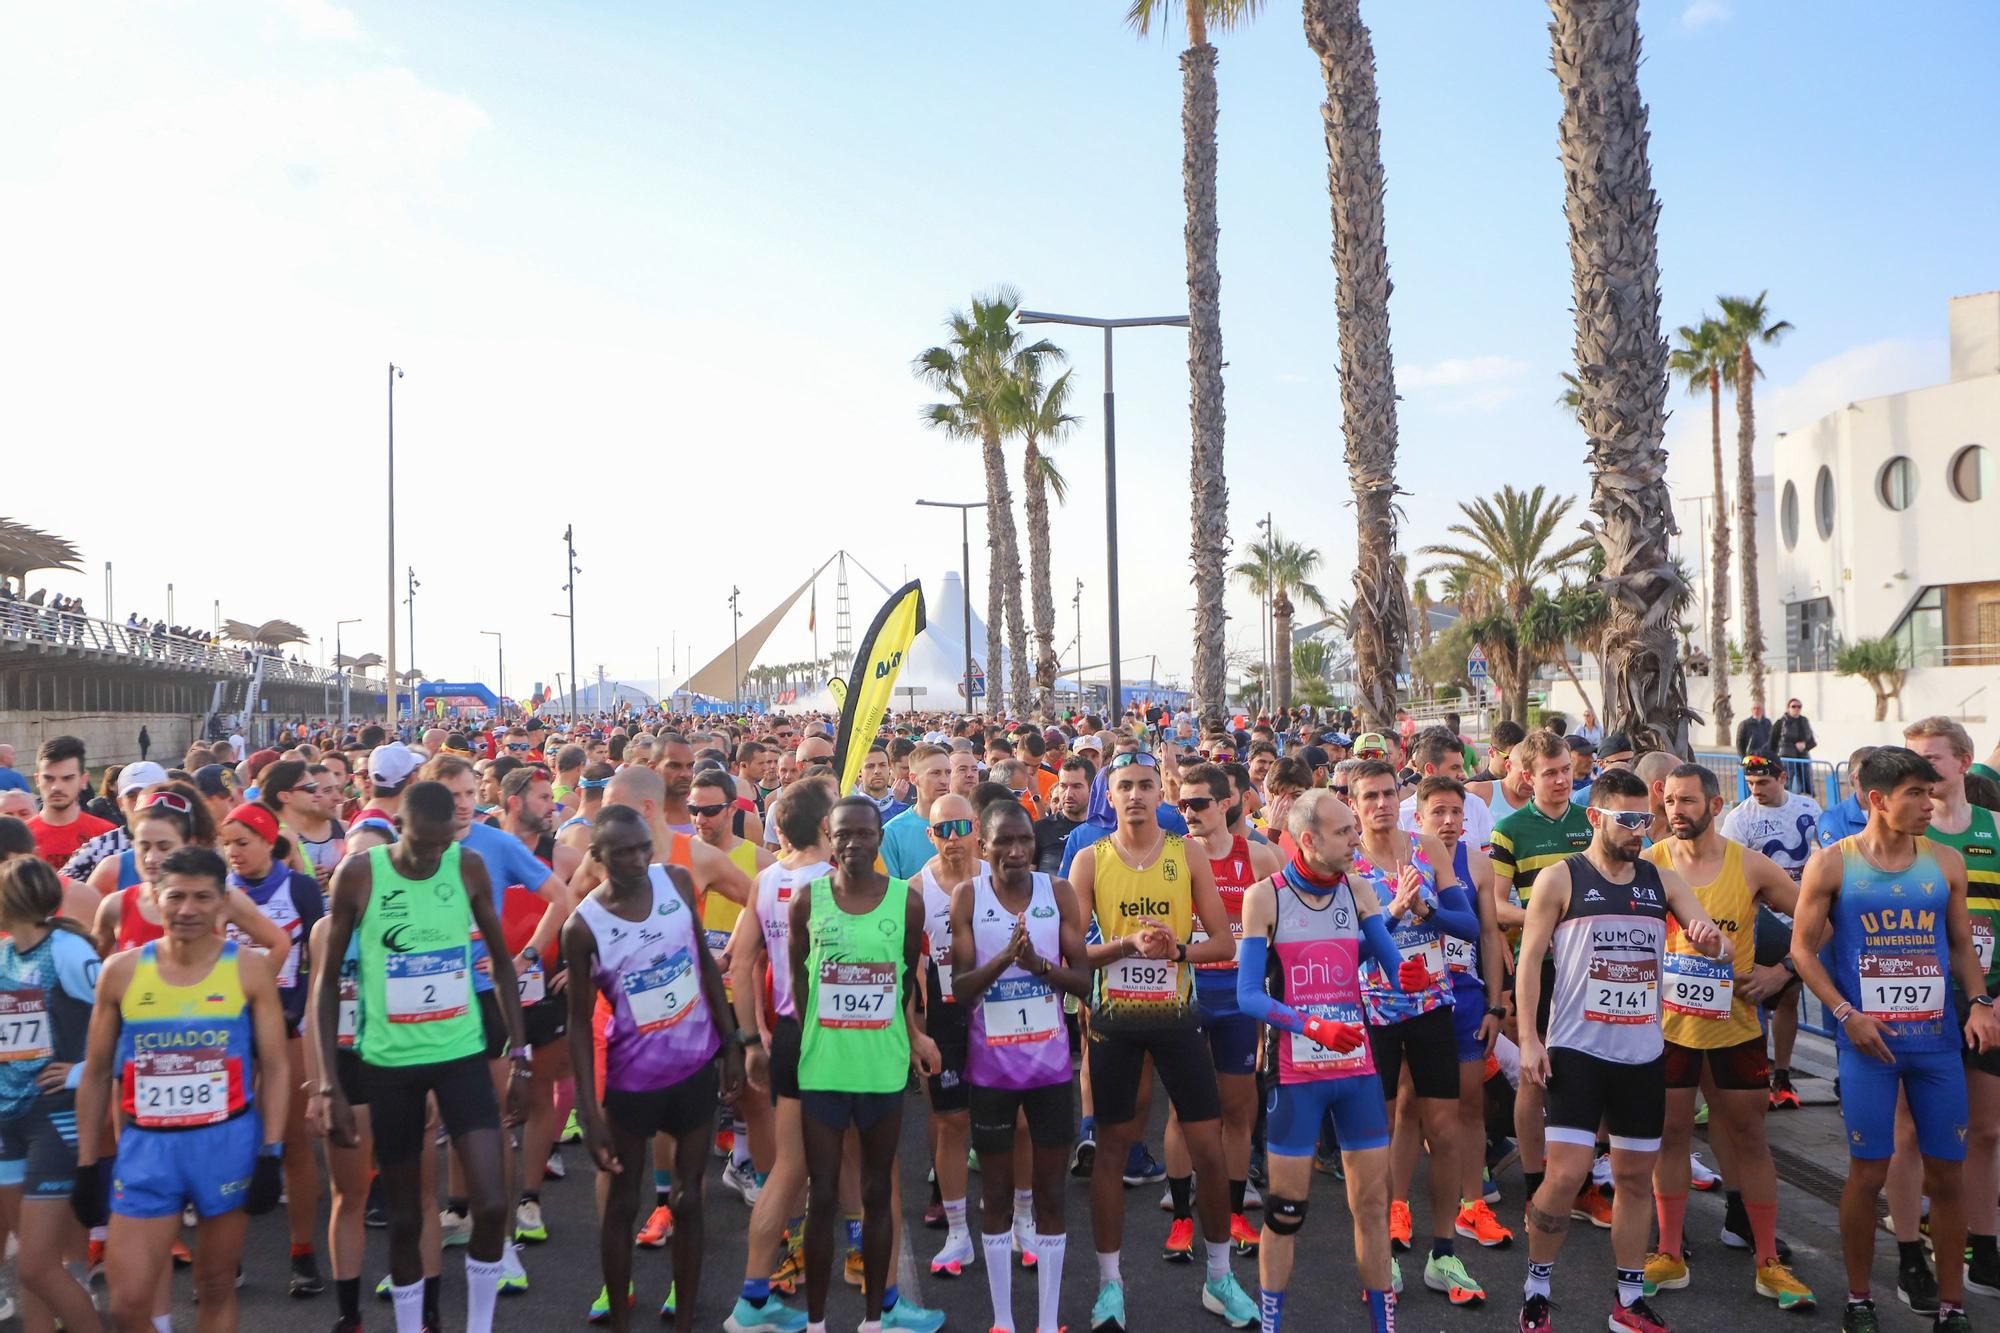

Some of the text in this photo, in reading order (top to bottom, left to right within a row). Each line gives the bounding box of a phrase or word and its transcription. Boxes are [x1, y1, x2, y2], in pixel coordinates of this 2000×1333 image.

[1120, 897, 1170, 917] teika
[1712, 918, 1739, 932] ra
[1860, 908, 1936, 934] UCAM
[1420, 931, 1436, 944] 21K
[1592, 928, 1657, 945] KUMON
[1972, 925, 1990, 936] 10K
[1865, 935, 1936, 946] UNIVERSIDAD
[1446, 942, 1464, 958] 94
[871, 973, 894, 984] 10K
[1120, 966, 1168, 984] 1592
[1639, 969, 1656, 981] 10K
[1708, 967, 1730, 979] 21K
[1915, 965, 1940, 976] 10K
[423, 985, 436, 1003] 2
[1031, 983, 1053, 996] 21K
[1599, 988, 1647, 1008] 2141
[1677, 983, 1715, 1003] 929
[1876, 986, 1932, 1004] 1797
[664, 992, 677, 1009] 3
[832, 994, 884, 1012] 1947
[1018, 1008, 1027, 1026] 1
[1340, 1009, 1359, 1022] 21K
[134, 1030, 230, 1052] ECUADOR
[149, 1083, 211, 1108] 2198
